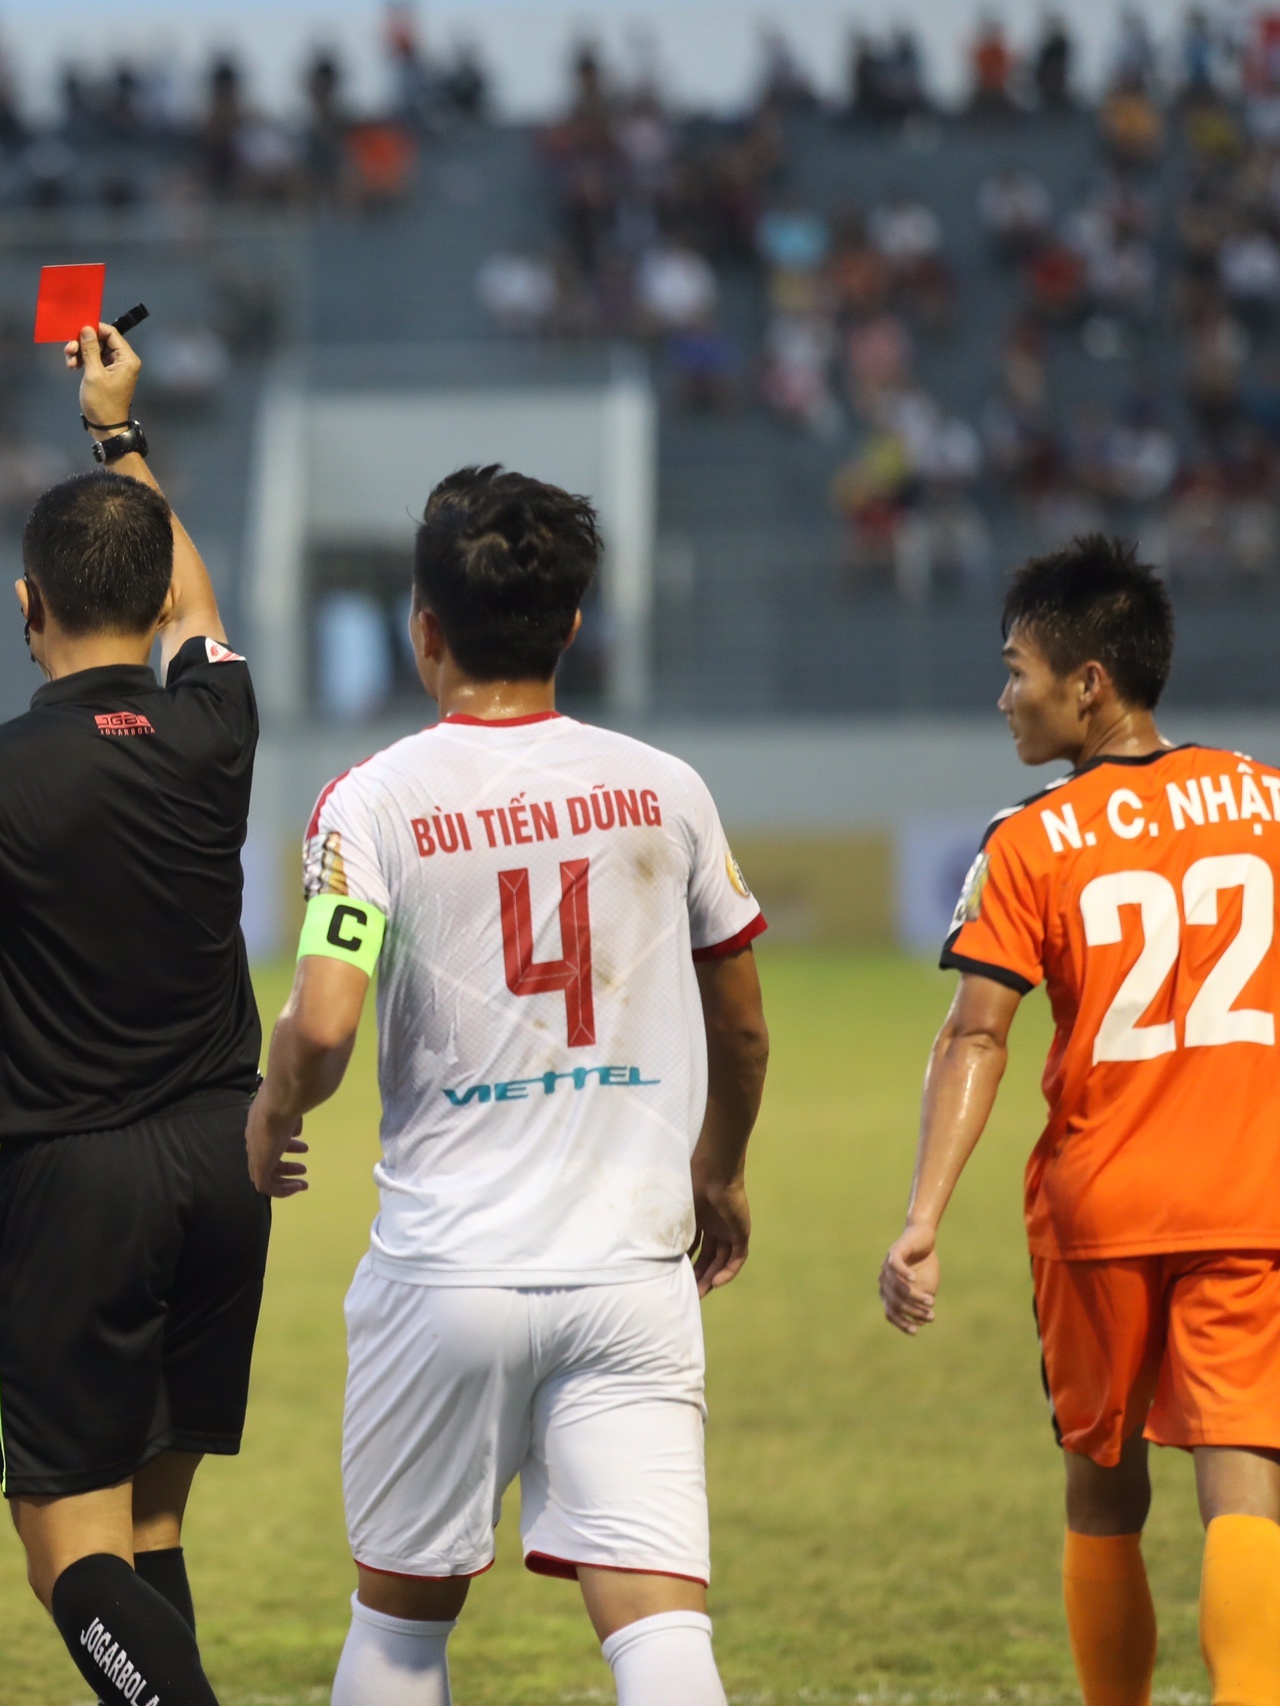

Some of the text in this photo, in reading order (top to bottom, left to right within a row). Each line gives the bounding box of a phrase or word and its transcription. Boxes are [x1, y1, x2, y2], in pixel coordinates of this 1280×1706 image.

[410, 783, 662, 858] BÙI TIẾN DŨNG
[1040, 802, 1097, 853] N.
[1107, 788, 1159, 839] C.
[326, 903, 368, 952] C
[498, 857, 596, 1048] 4
[1079, 853, 1276, 1067] 22
[442, 1066, 661, 1106] VIETTEL
